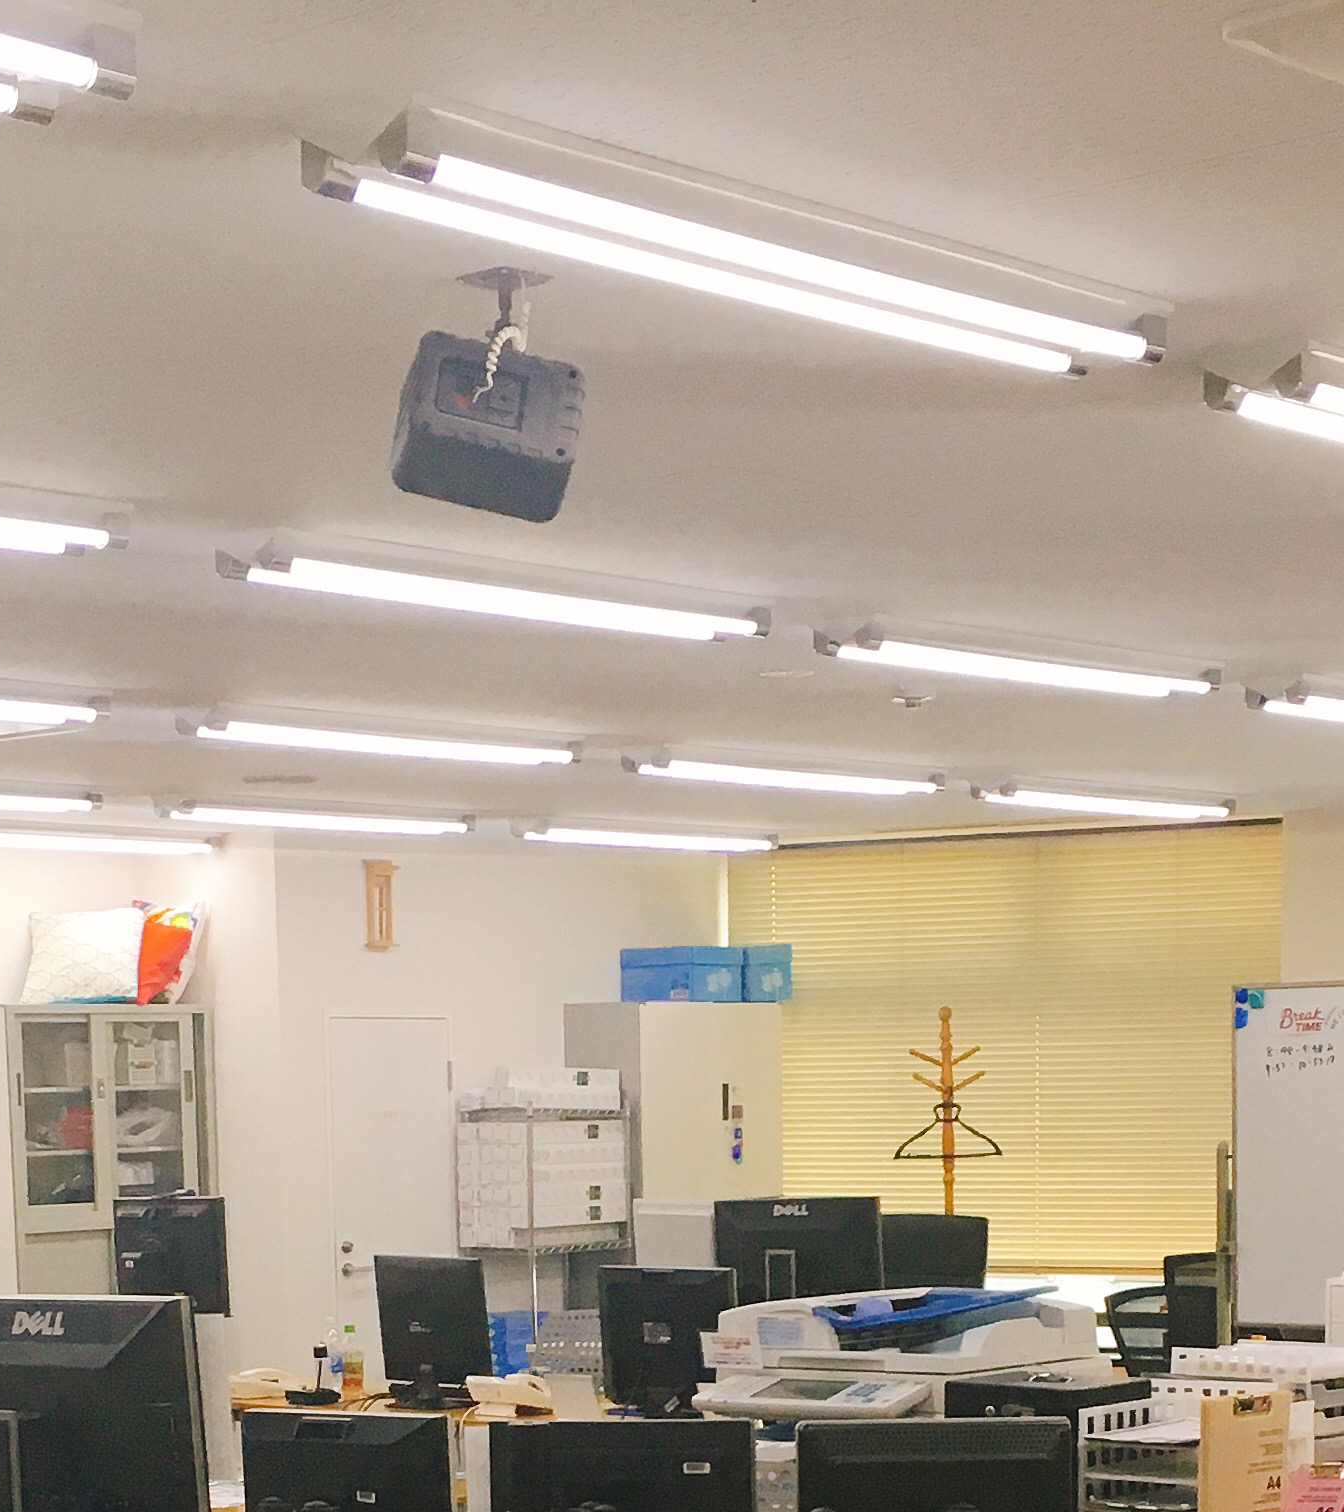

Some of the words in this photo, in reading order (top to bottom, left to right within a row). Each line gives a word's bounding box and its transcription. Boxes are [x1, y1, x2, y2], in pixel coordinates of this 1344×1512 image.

[1279, 1008, 1326, 1029] Break
[1295, 1021, 1323, 1032] TIME
[773, 1204, 809, 1217] DELL
[11, 1310, 65, 1336] DELL
[1266, 1476, 1281, 1490] A4
